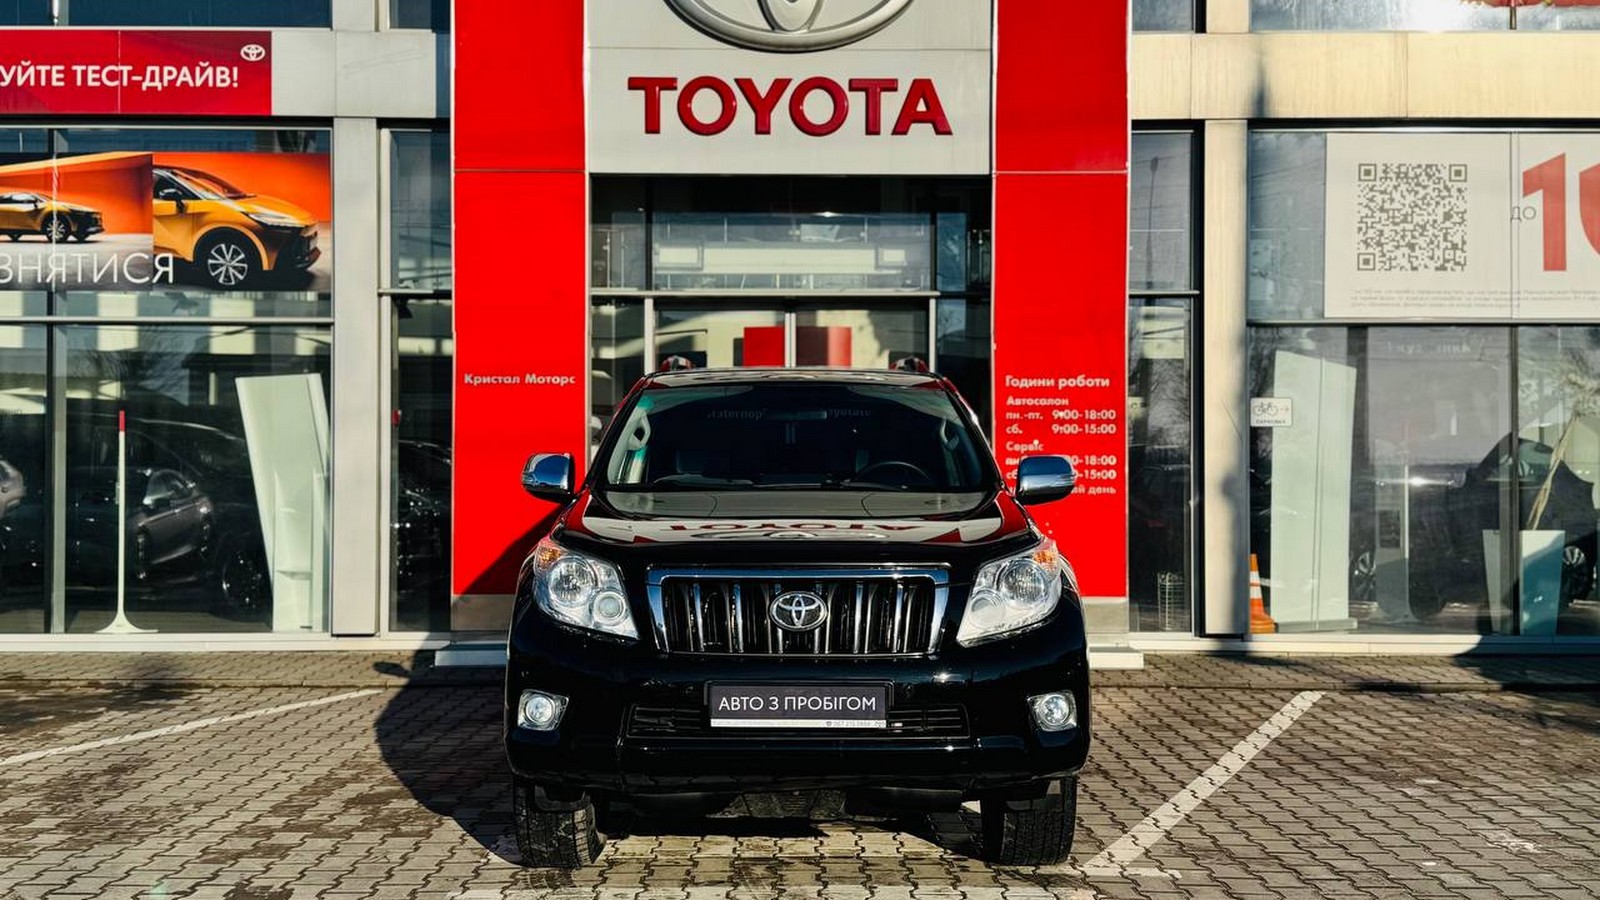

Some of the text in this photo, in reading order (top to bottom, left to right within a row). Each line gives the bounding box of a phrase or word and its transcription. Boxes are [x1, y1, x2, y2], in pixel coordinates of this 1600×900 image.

[0, 60, 239, 90] УЙТЕ ТЕСТ-ДРАЙВ!
[628, 76, 952, 136] TOYOTA
[464, 373, 575, 386] Кристал Моторс
[1005, 375, 1110, 390] Години роботи
[1006, 396, 1069, 406] Автосалон
[1051, 409, 1117, 420] 9:00-18:00
[1006, 424, 1117, 434] сб. 9:00-15:00
[1070, 455, 1117, 465] 0-18:00
[718, 696, 876, 711] АВТО З ПРОБІГОМ
